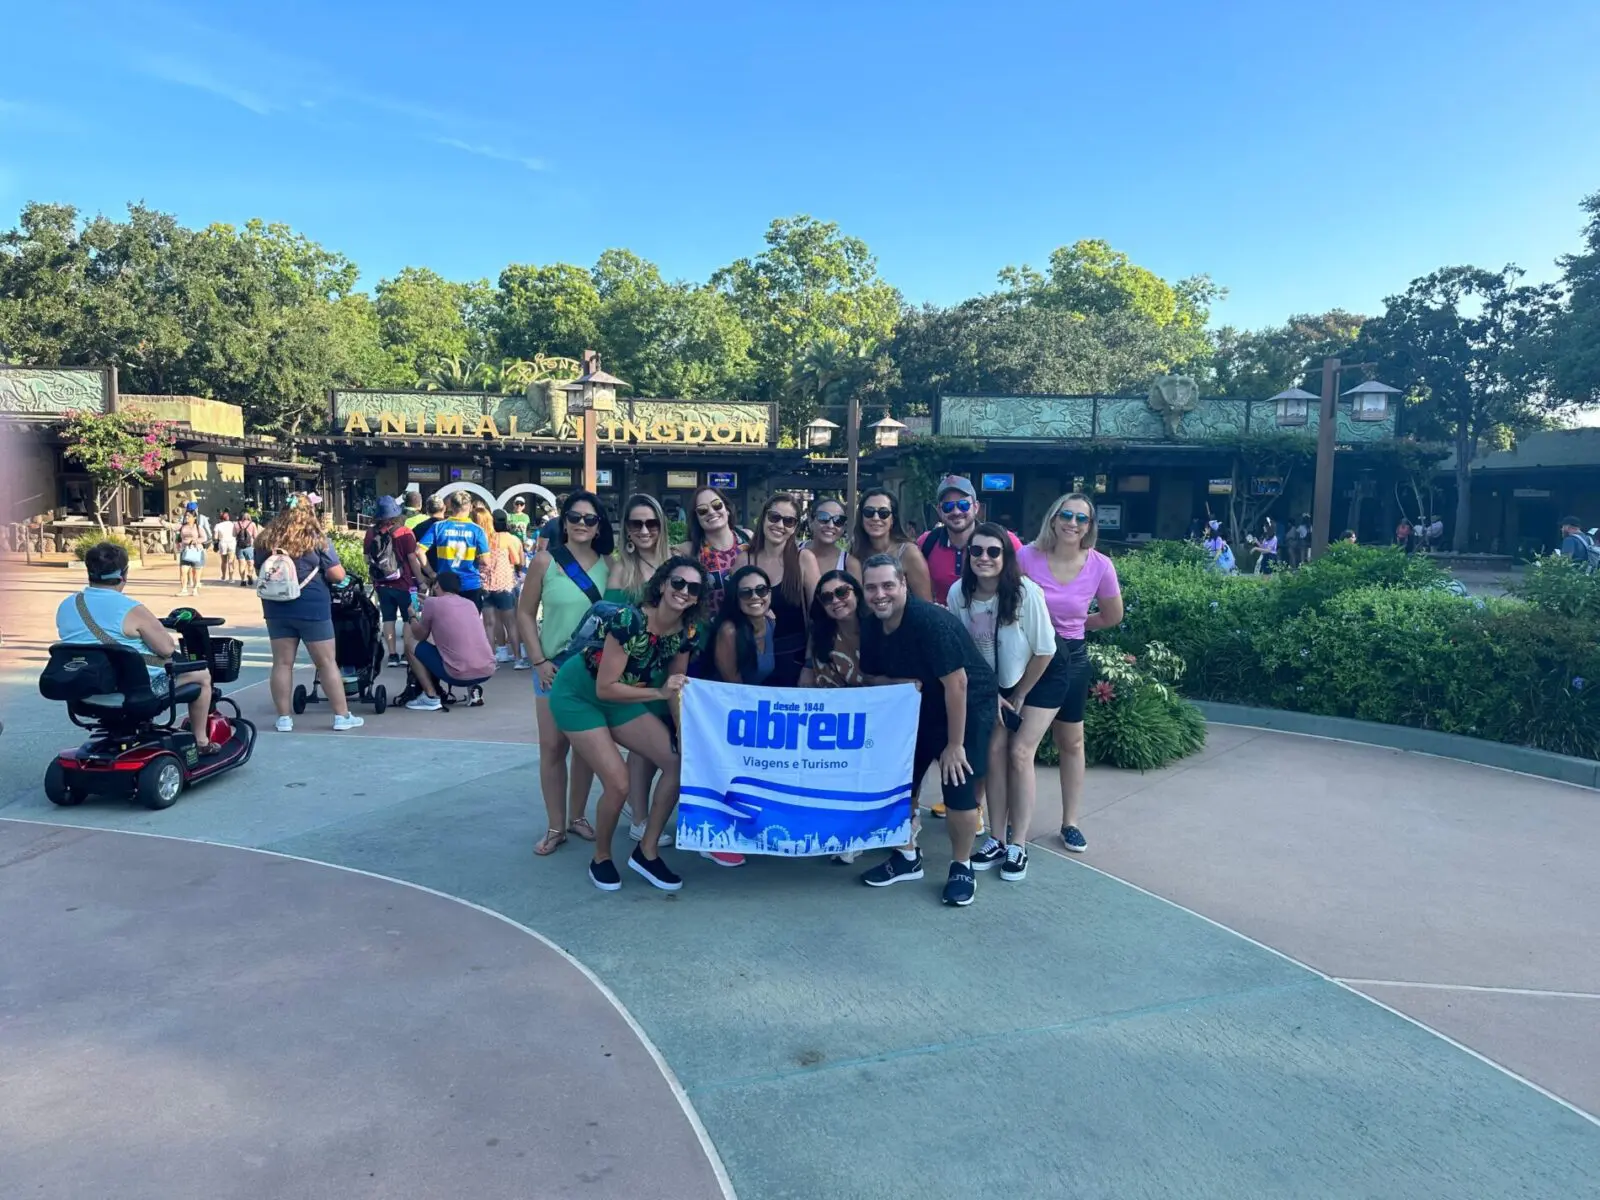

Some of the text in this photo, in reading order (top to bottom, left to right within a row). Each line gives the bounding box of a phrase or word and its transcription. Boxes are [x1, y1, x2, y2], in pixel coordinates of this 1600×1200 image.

[344, 411, 532, 438] ANIMAL
[773, 702, 800, 712] desde
[726, 700, 867, 750] abreu
[743, 755, 849, 770] Viagens e Turismo
